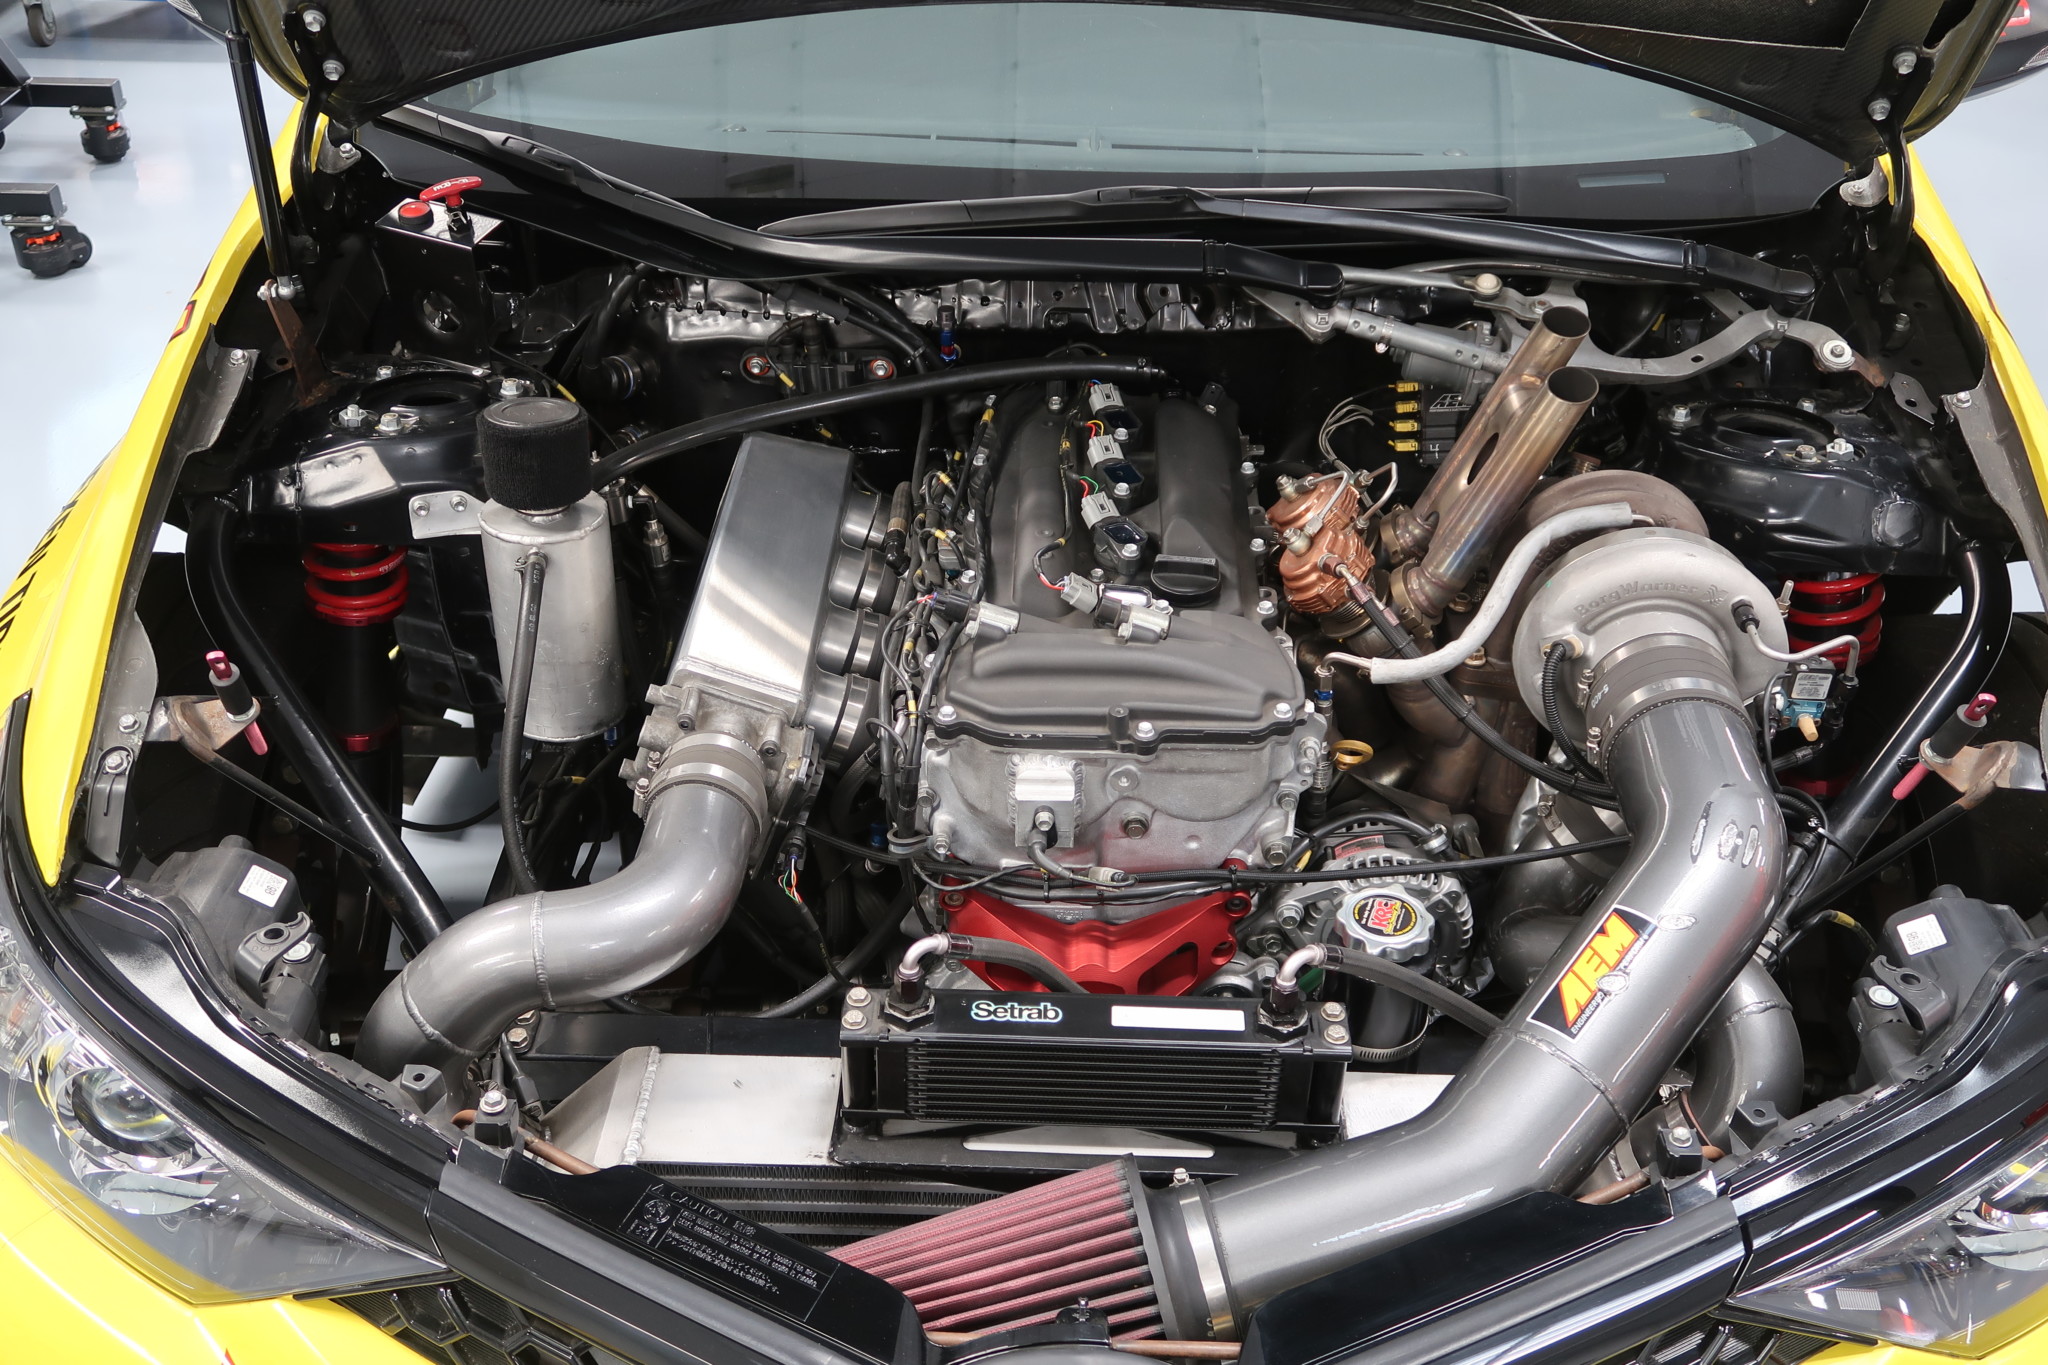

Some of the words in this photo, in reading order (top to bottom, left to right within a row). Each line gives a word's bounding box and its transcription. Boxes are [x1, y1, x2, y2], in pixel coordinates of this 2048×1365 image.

[1574, 581, 1699, 617] BorgWarner
[1558, 911, 1640, 1029] AEM
[971, 1000, 1063, 1023] Setrab
[670, 1191, 728, 1224] CAUTION
